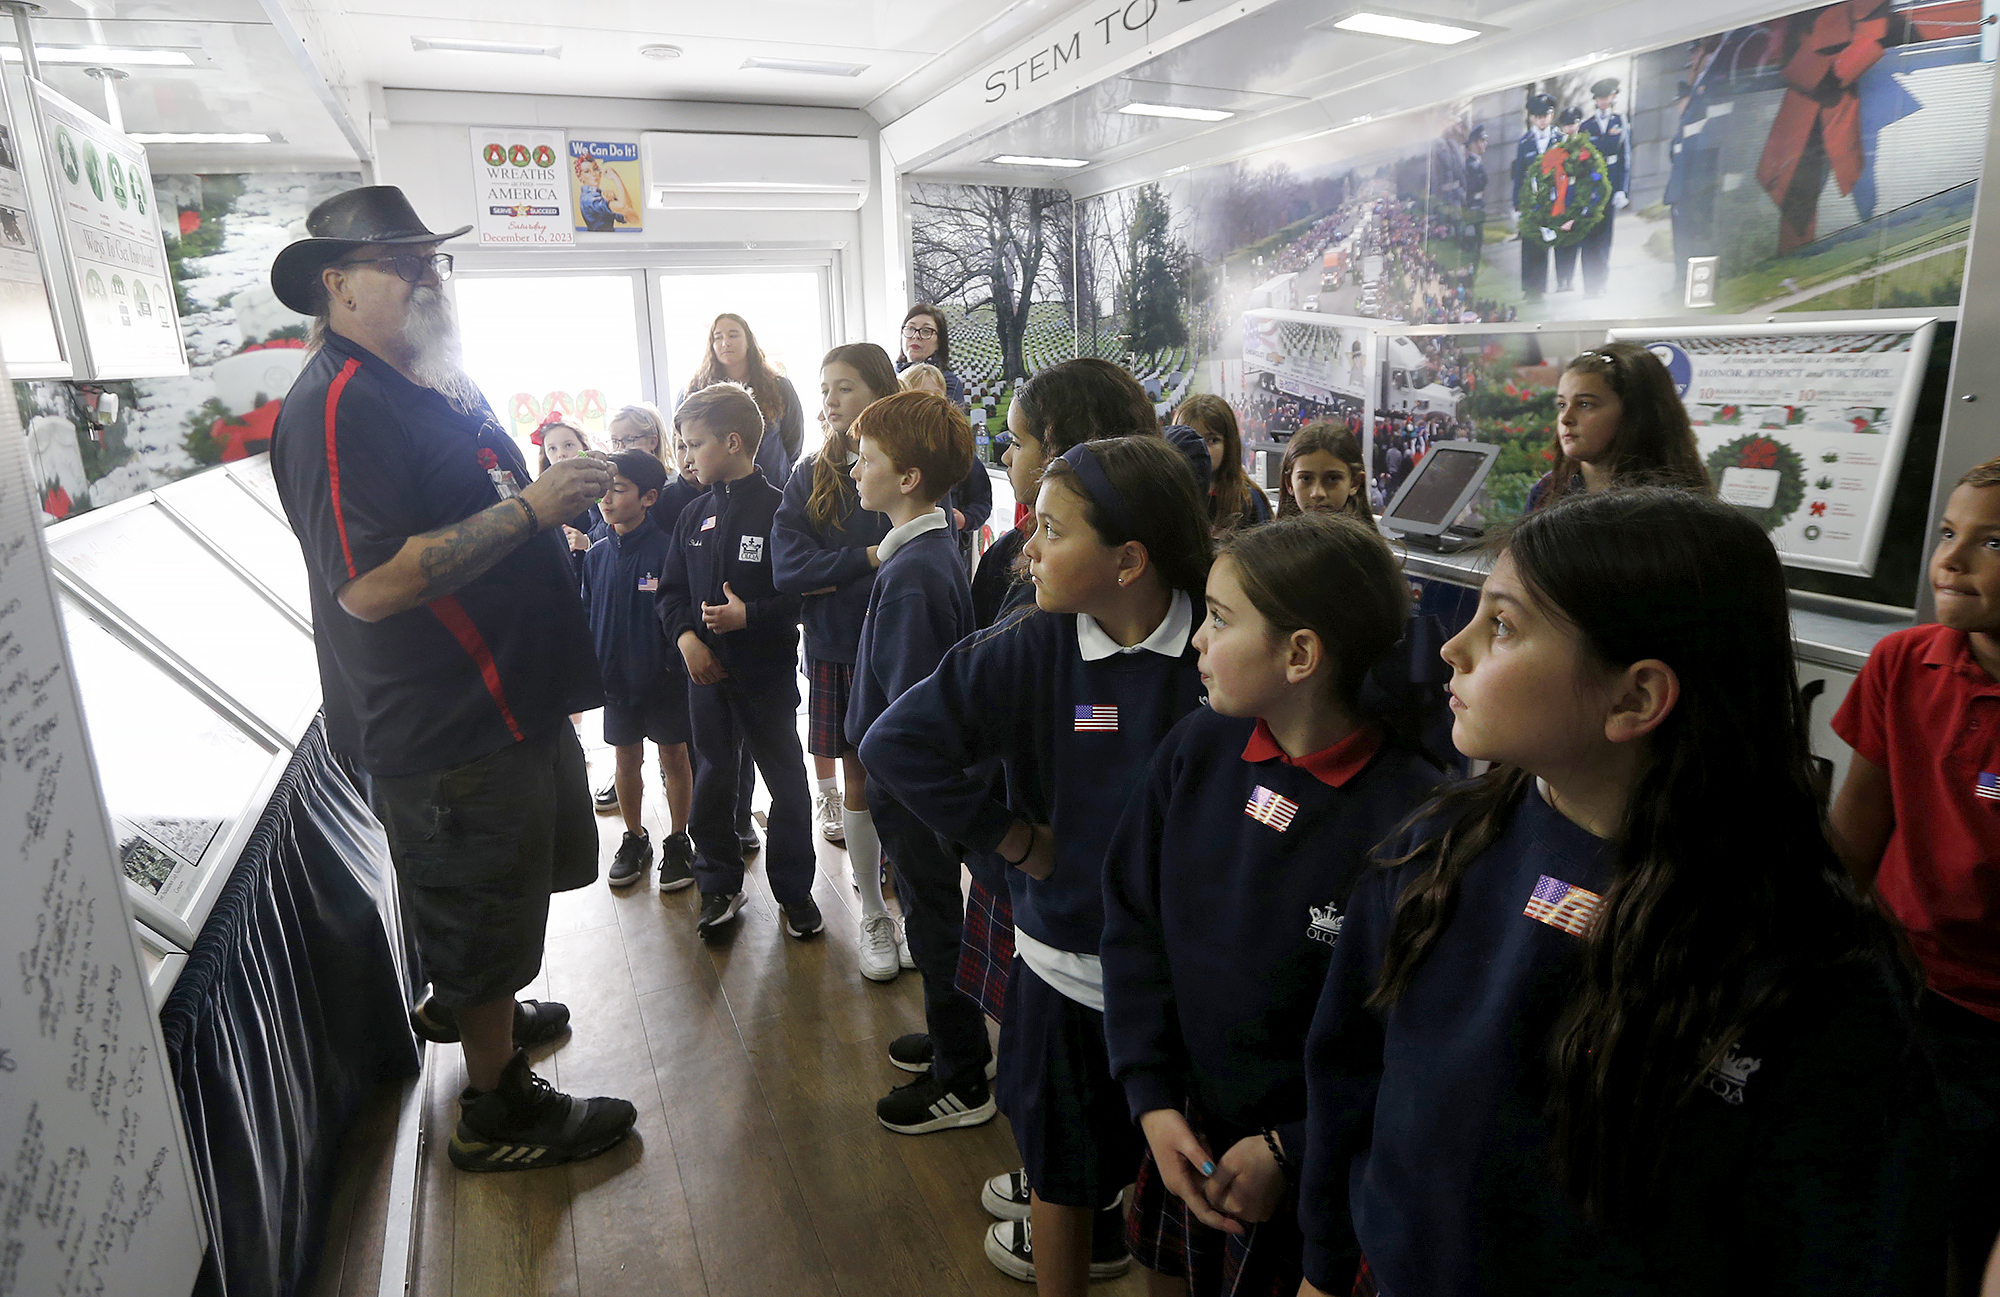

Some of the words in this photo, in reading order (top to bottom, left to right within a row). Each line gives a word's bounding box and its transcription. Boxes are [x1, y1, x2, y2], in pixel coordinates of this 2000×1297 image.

[985, 31, 1082, 104] STEM
[1095, 0, 1158, 45] TO
[572, 142, 588, 155] We
[589, 143, 609, 156] Can
[609, 144, 624, 156] Do
[624, 144, 636, 157] It!
[486, 167, 555, 180] WREATHS
[487, 187, 558, 200] AMERICA
[492, 206, 513, 214] SERVE
[529, 207, 558, 215] SUCCEED
[508, 220, 547, 234] Saturday
[482, 232, 530, 242] December
[533, 232, 548, 243] 16,
[550, 232, 573, 242] 2023
[83, 228, 105, 259] Ways
[104, 235, 115, 258] To
[115, 239, 130, 262] Get
[1747, 368, 1804, 378] RESPECT
[1699, 387, 1715, 399] 10
[1798, 389, 1816, 401] 10
[1306, 927, 1336, 948] OLQ
